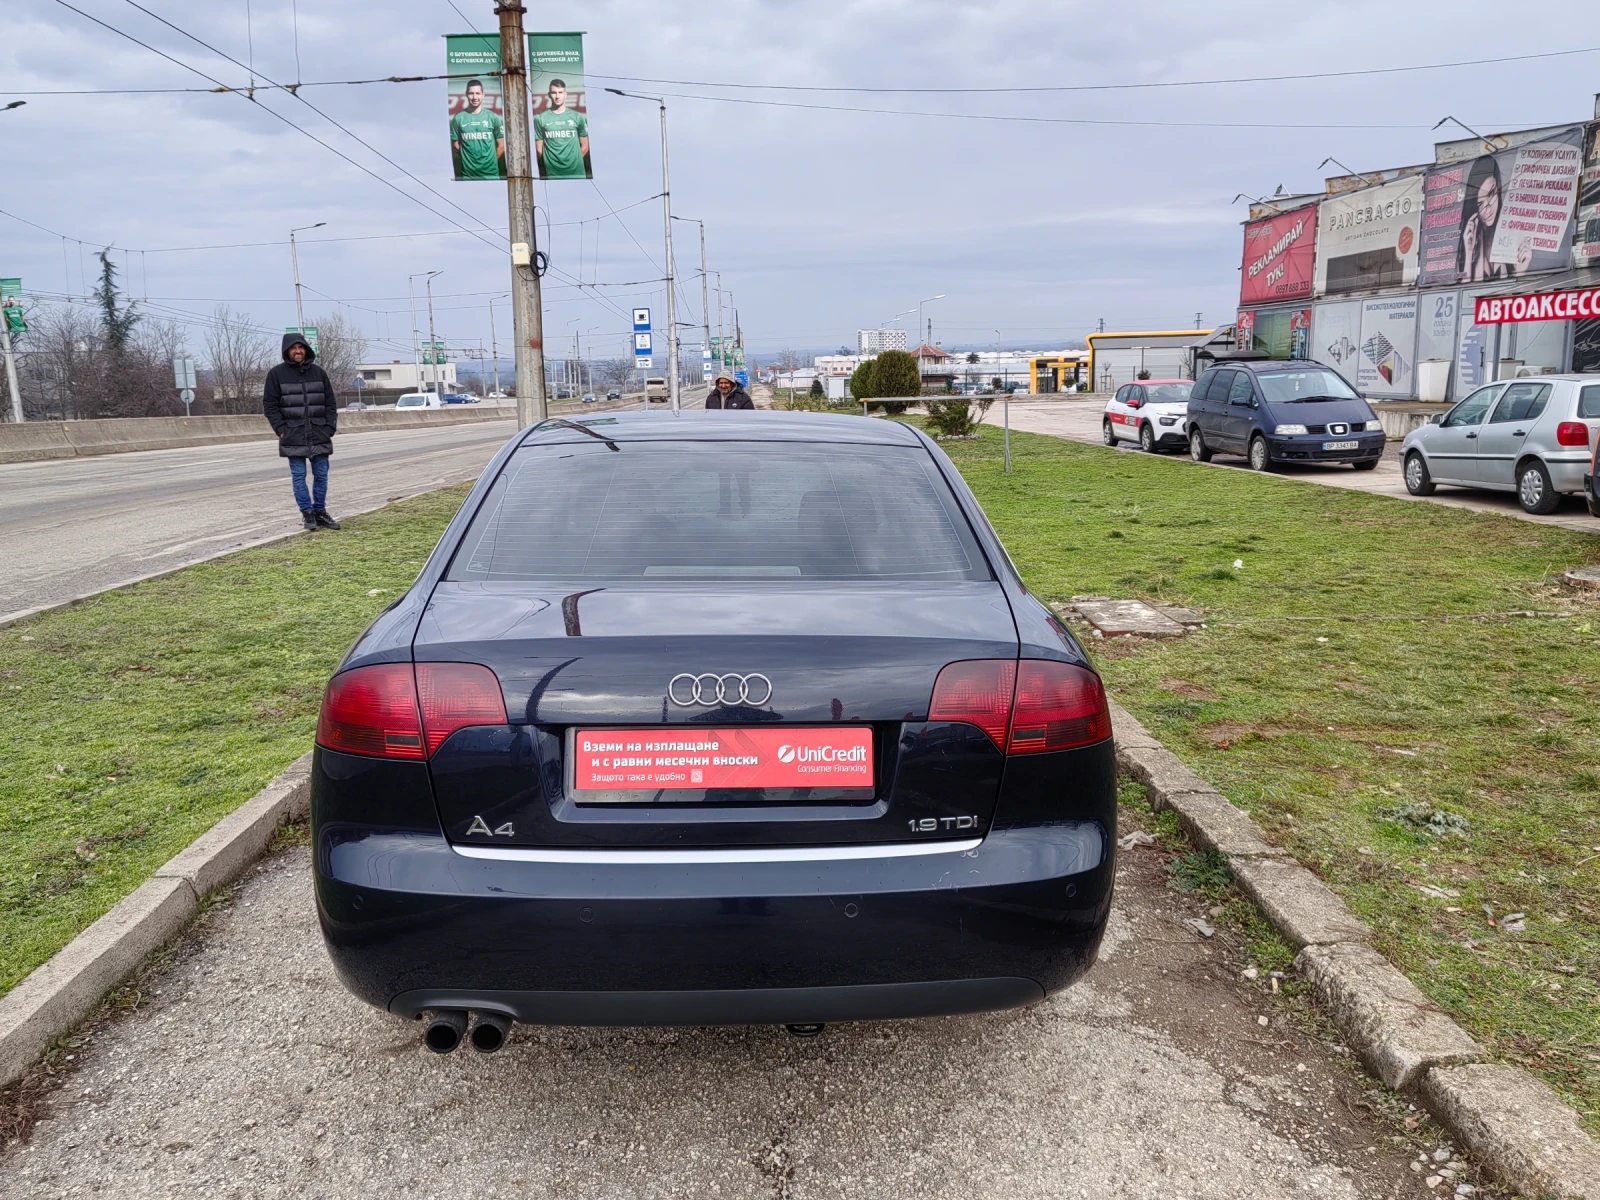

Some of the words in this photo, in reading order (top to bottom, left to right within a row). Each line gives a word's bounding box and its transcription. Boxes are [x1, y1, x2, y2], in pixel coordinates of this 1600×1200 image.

[461, 132, 492, 140] WINBET
[545, 130, 576, 138] WINBET
[1527, 150, 1554, 159] КОПИРНИ
[1555, 150, 1577, 160] УСЛУГИ
[1521, 164, 1550, 174] ГРАФИЧЕН
[1551, 164, 1576, 176] ДИЗАЙН
[1519, 179, 1544, 189] ПЕЧАТНА
[1544, 180, 1572, 191] РЕКЛАМА
[1514, 193, 1539, 204] ВЪНШНА
[1540, 194, 1567, 206] РЕКЛАМА
[1330, 198, 1411, 231] PANCRACIO
[1508, 206, 1537, 218] РЕКЛАМНИ
[1538, 209, 1567, 221] СУВЕНИРИ
[1364, 228, 1390, 238] CHOCOLATE
[1508, 220, 1535, 231] ФИРМЕНИ
[1537, 224, 1560, 234] ПЕЧАТИ
[1248, 217, 1303, 280] РЕКЛАМИРАЙ
[1533, 237, 1558, 249] ТЕНИСКИ
[1266, 263, 1284, 287] ТУК!
[1276, 283, 1288, 294] 0897
[1366, 301, 1416, 311] ВИСОКОТЕХНОЛОГИЧНИ
[1435, 296, 1453, 318] 25
[1389, 312, 1415, 320] МАТЕРИАЛИ
[583, 741, 624, 752] Вземи
[627, 742, 642, 751] на
[645, 741, 719, 754] изплащане
[797, 745, 867, 762] UniCredit
[592, 758, 600, 766] и
[602, 758, 610, 766] с
[613, 757, 652, 768] равни
[655, 756, 710, 766] месечни
[712, 756, 759, 765] вноски
[797, 765, 832, 773] Consumer
[834, 764, 867, 774] Financing
[591, 773, 624, 782] Защото
[626, 773, 646, 781] така
[655, 772, 686, 783] удобно
[466, 816, 514, 837] A4
[908, 818, 937, 832] 1.9
[940, 816, 978, 830] TDI
